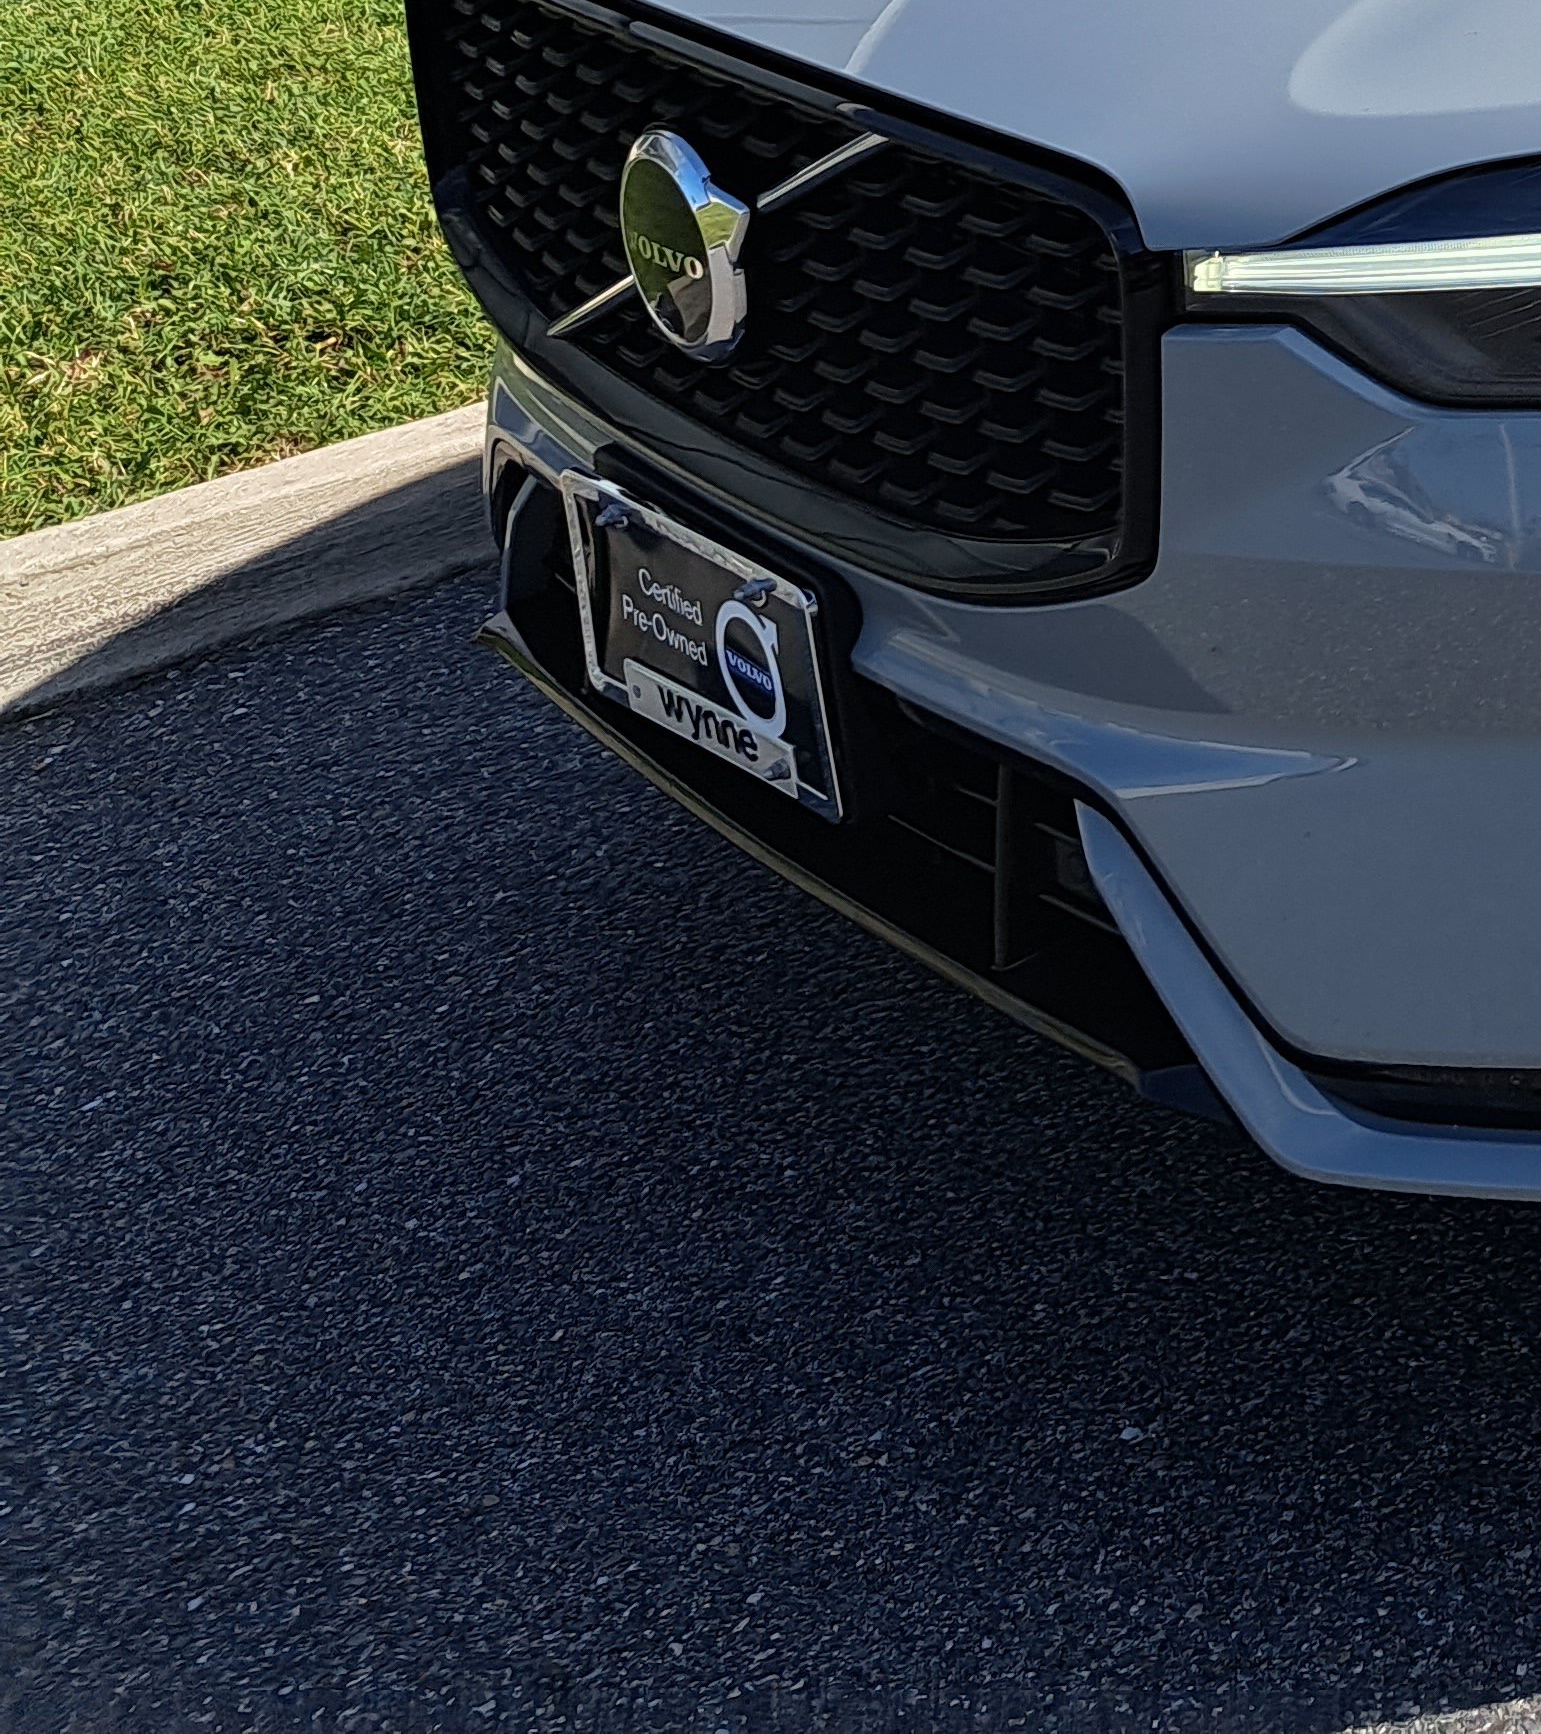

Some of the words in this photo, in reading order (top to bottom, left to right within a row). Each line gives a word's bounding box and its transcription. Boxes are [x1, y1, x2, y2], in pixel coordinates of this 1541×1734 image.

[628, 231, 704, 280] VOLVO
[637, 568, 704, 626] Certified
[621, 593, 709, 667] Pre-Owned
[724, 649, 774, 692] VOLVO
[656, 684, 760, 763] wynne
